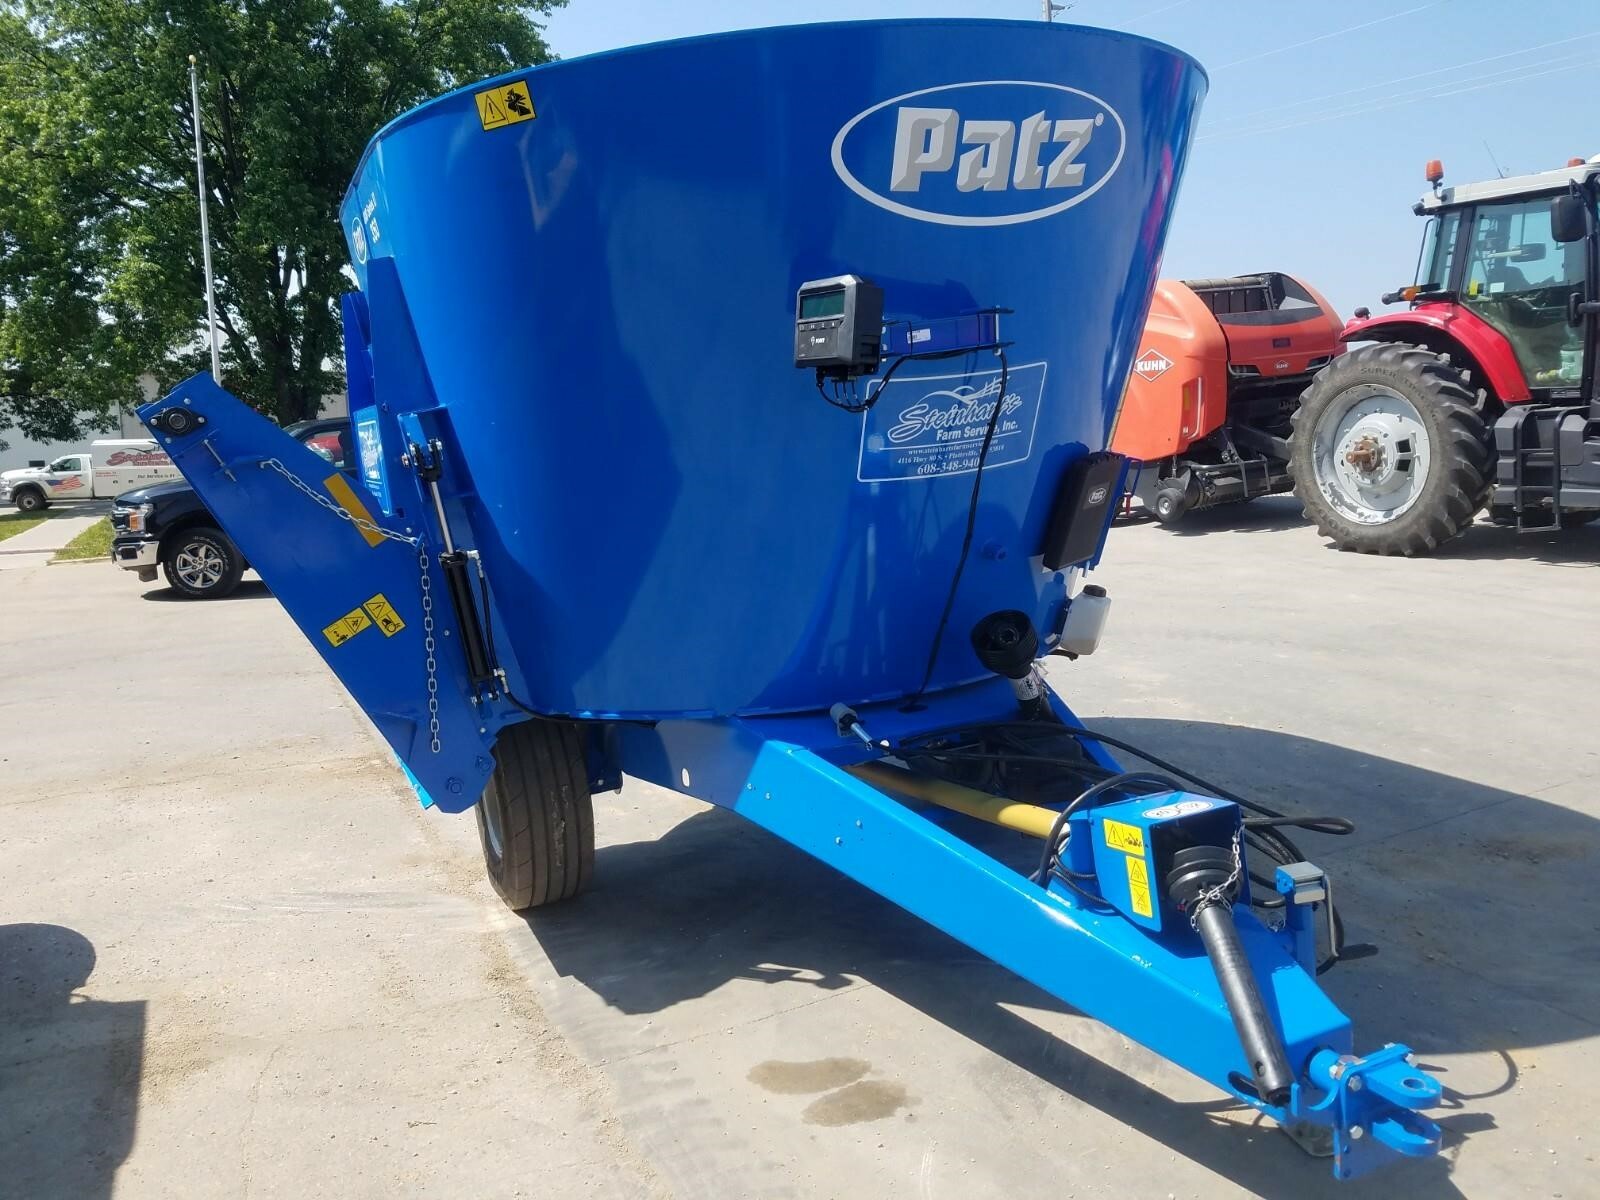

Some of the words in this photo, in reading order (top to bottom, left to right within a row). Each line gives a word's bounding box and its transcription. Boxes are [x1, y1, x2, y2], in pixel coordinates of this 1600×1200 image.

[890, 106, 1095, 193] Patz
[1136, 360, 1168, 372] KUHN
[936, 429, 961, 441] Farm
[1002, 420, 1018, 431] Inc.
[917, 457, 981, 475] 608-348-940
